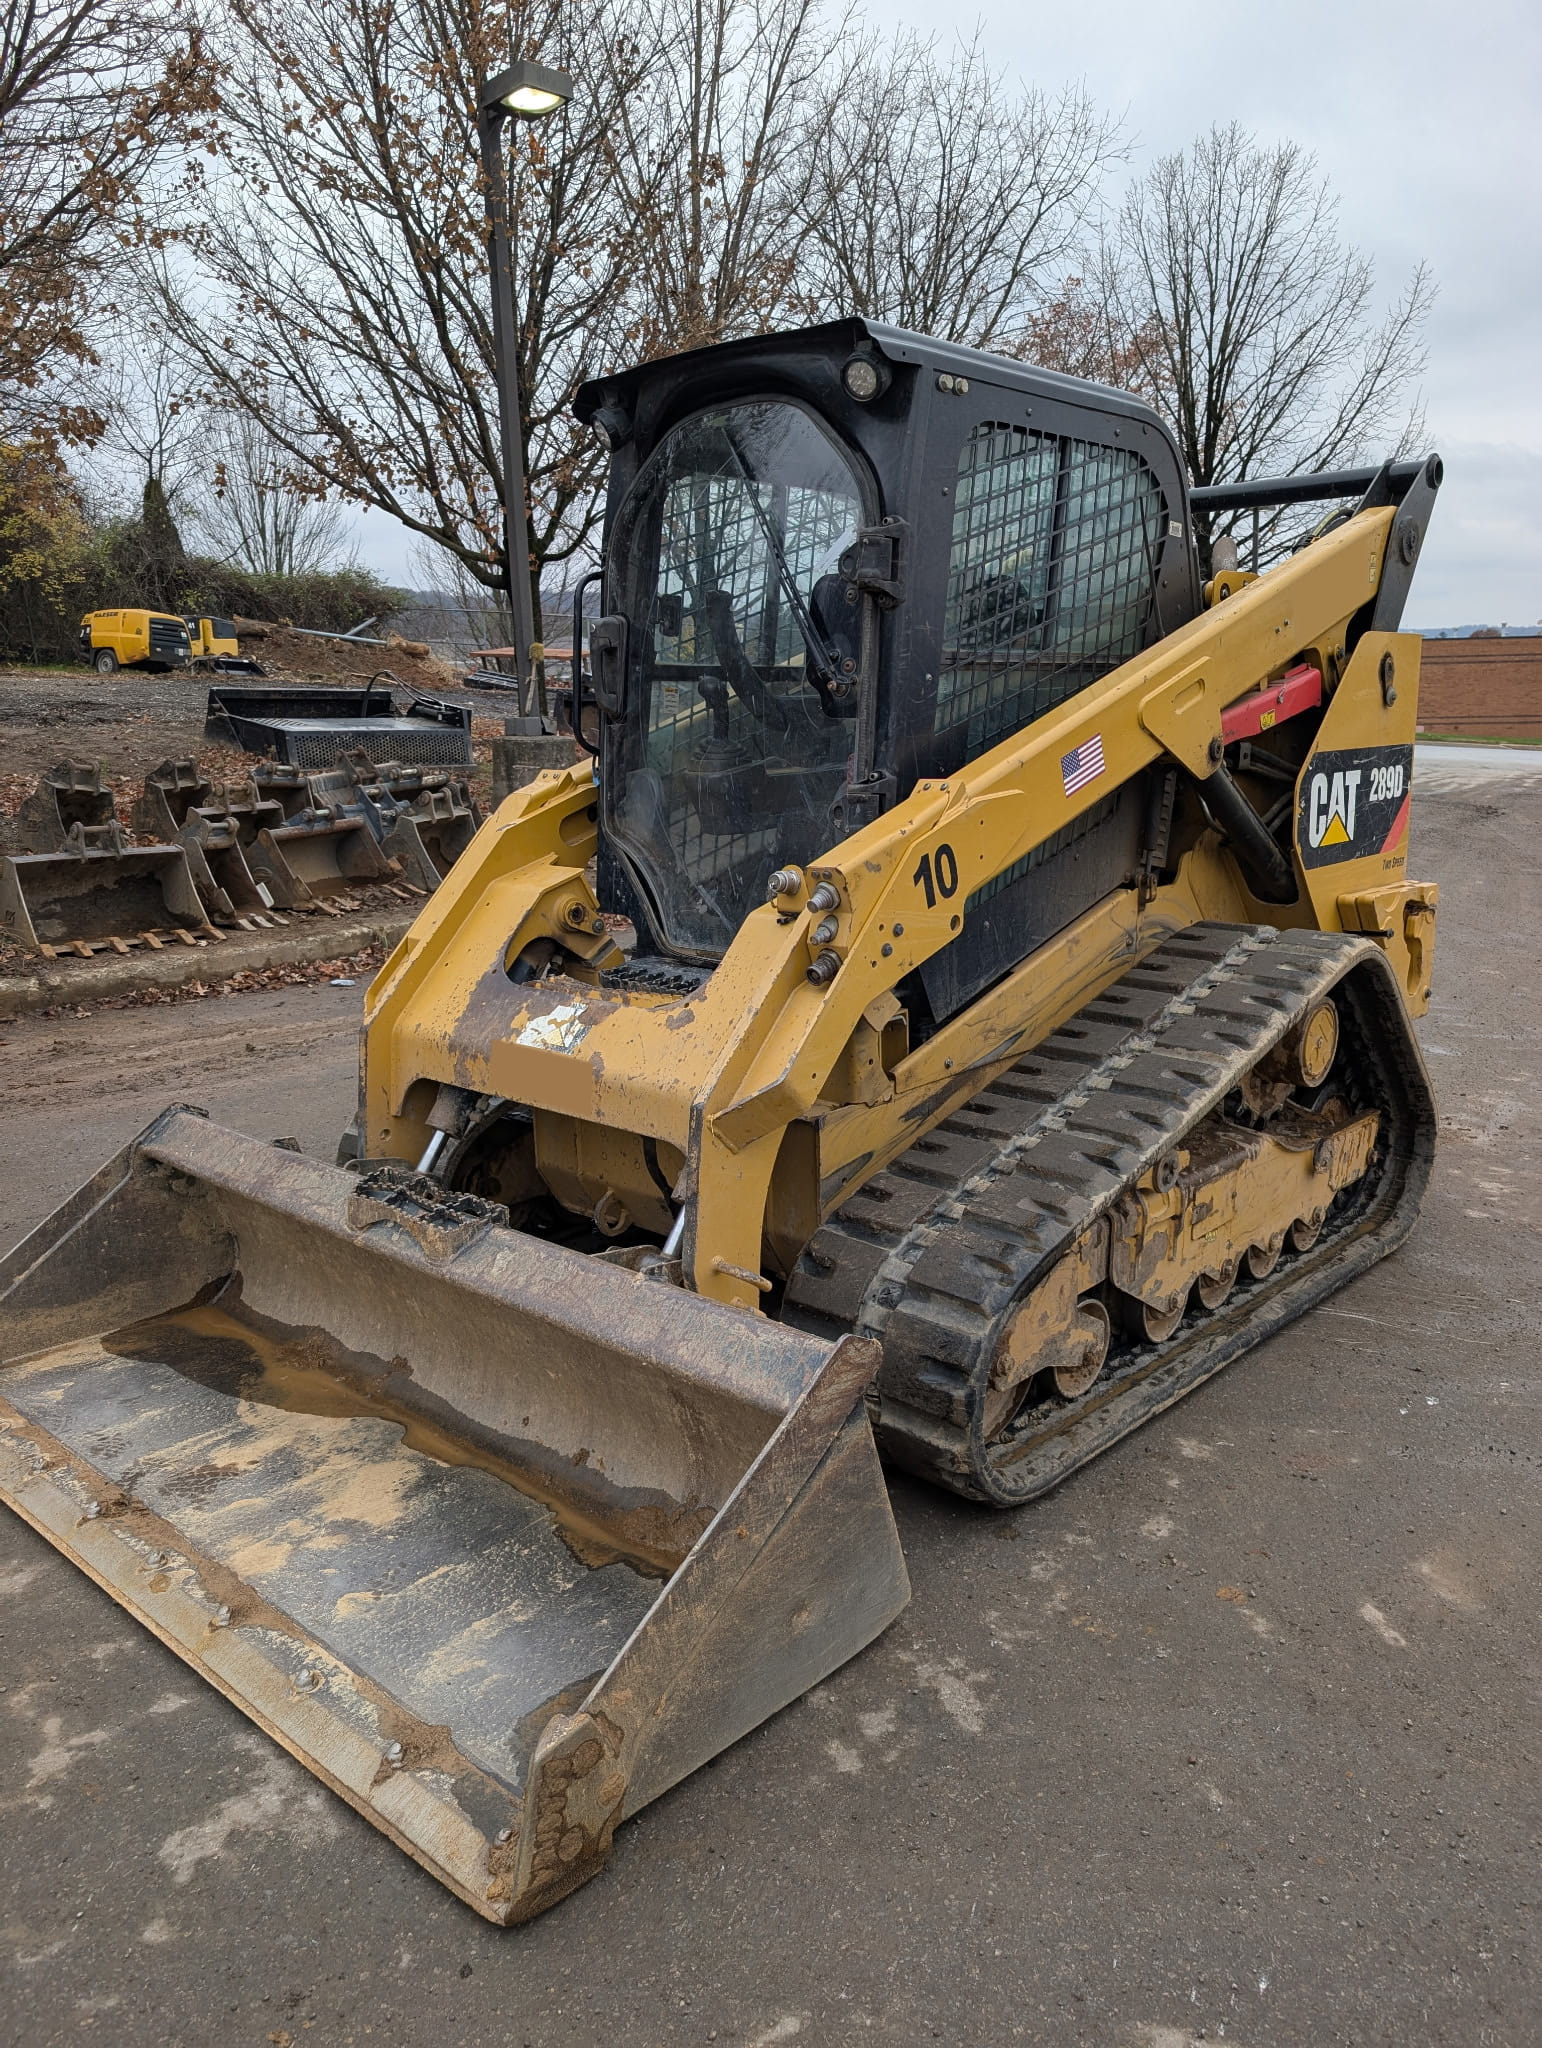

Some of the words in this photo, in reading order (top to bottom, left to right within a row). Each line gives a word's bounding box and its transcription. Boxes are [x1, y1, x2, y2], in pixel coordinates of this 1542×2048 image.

[1309, 769, 1361, 848] CAT
[1369, 765, 1404, 801] 289D
[913, 843, 959, 910] 10
